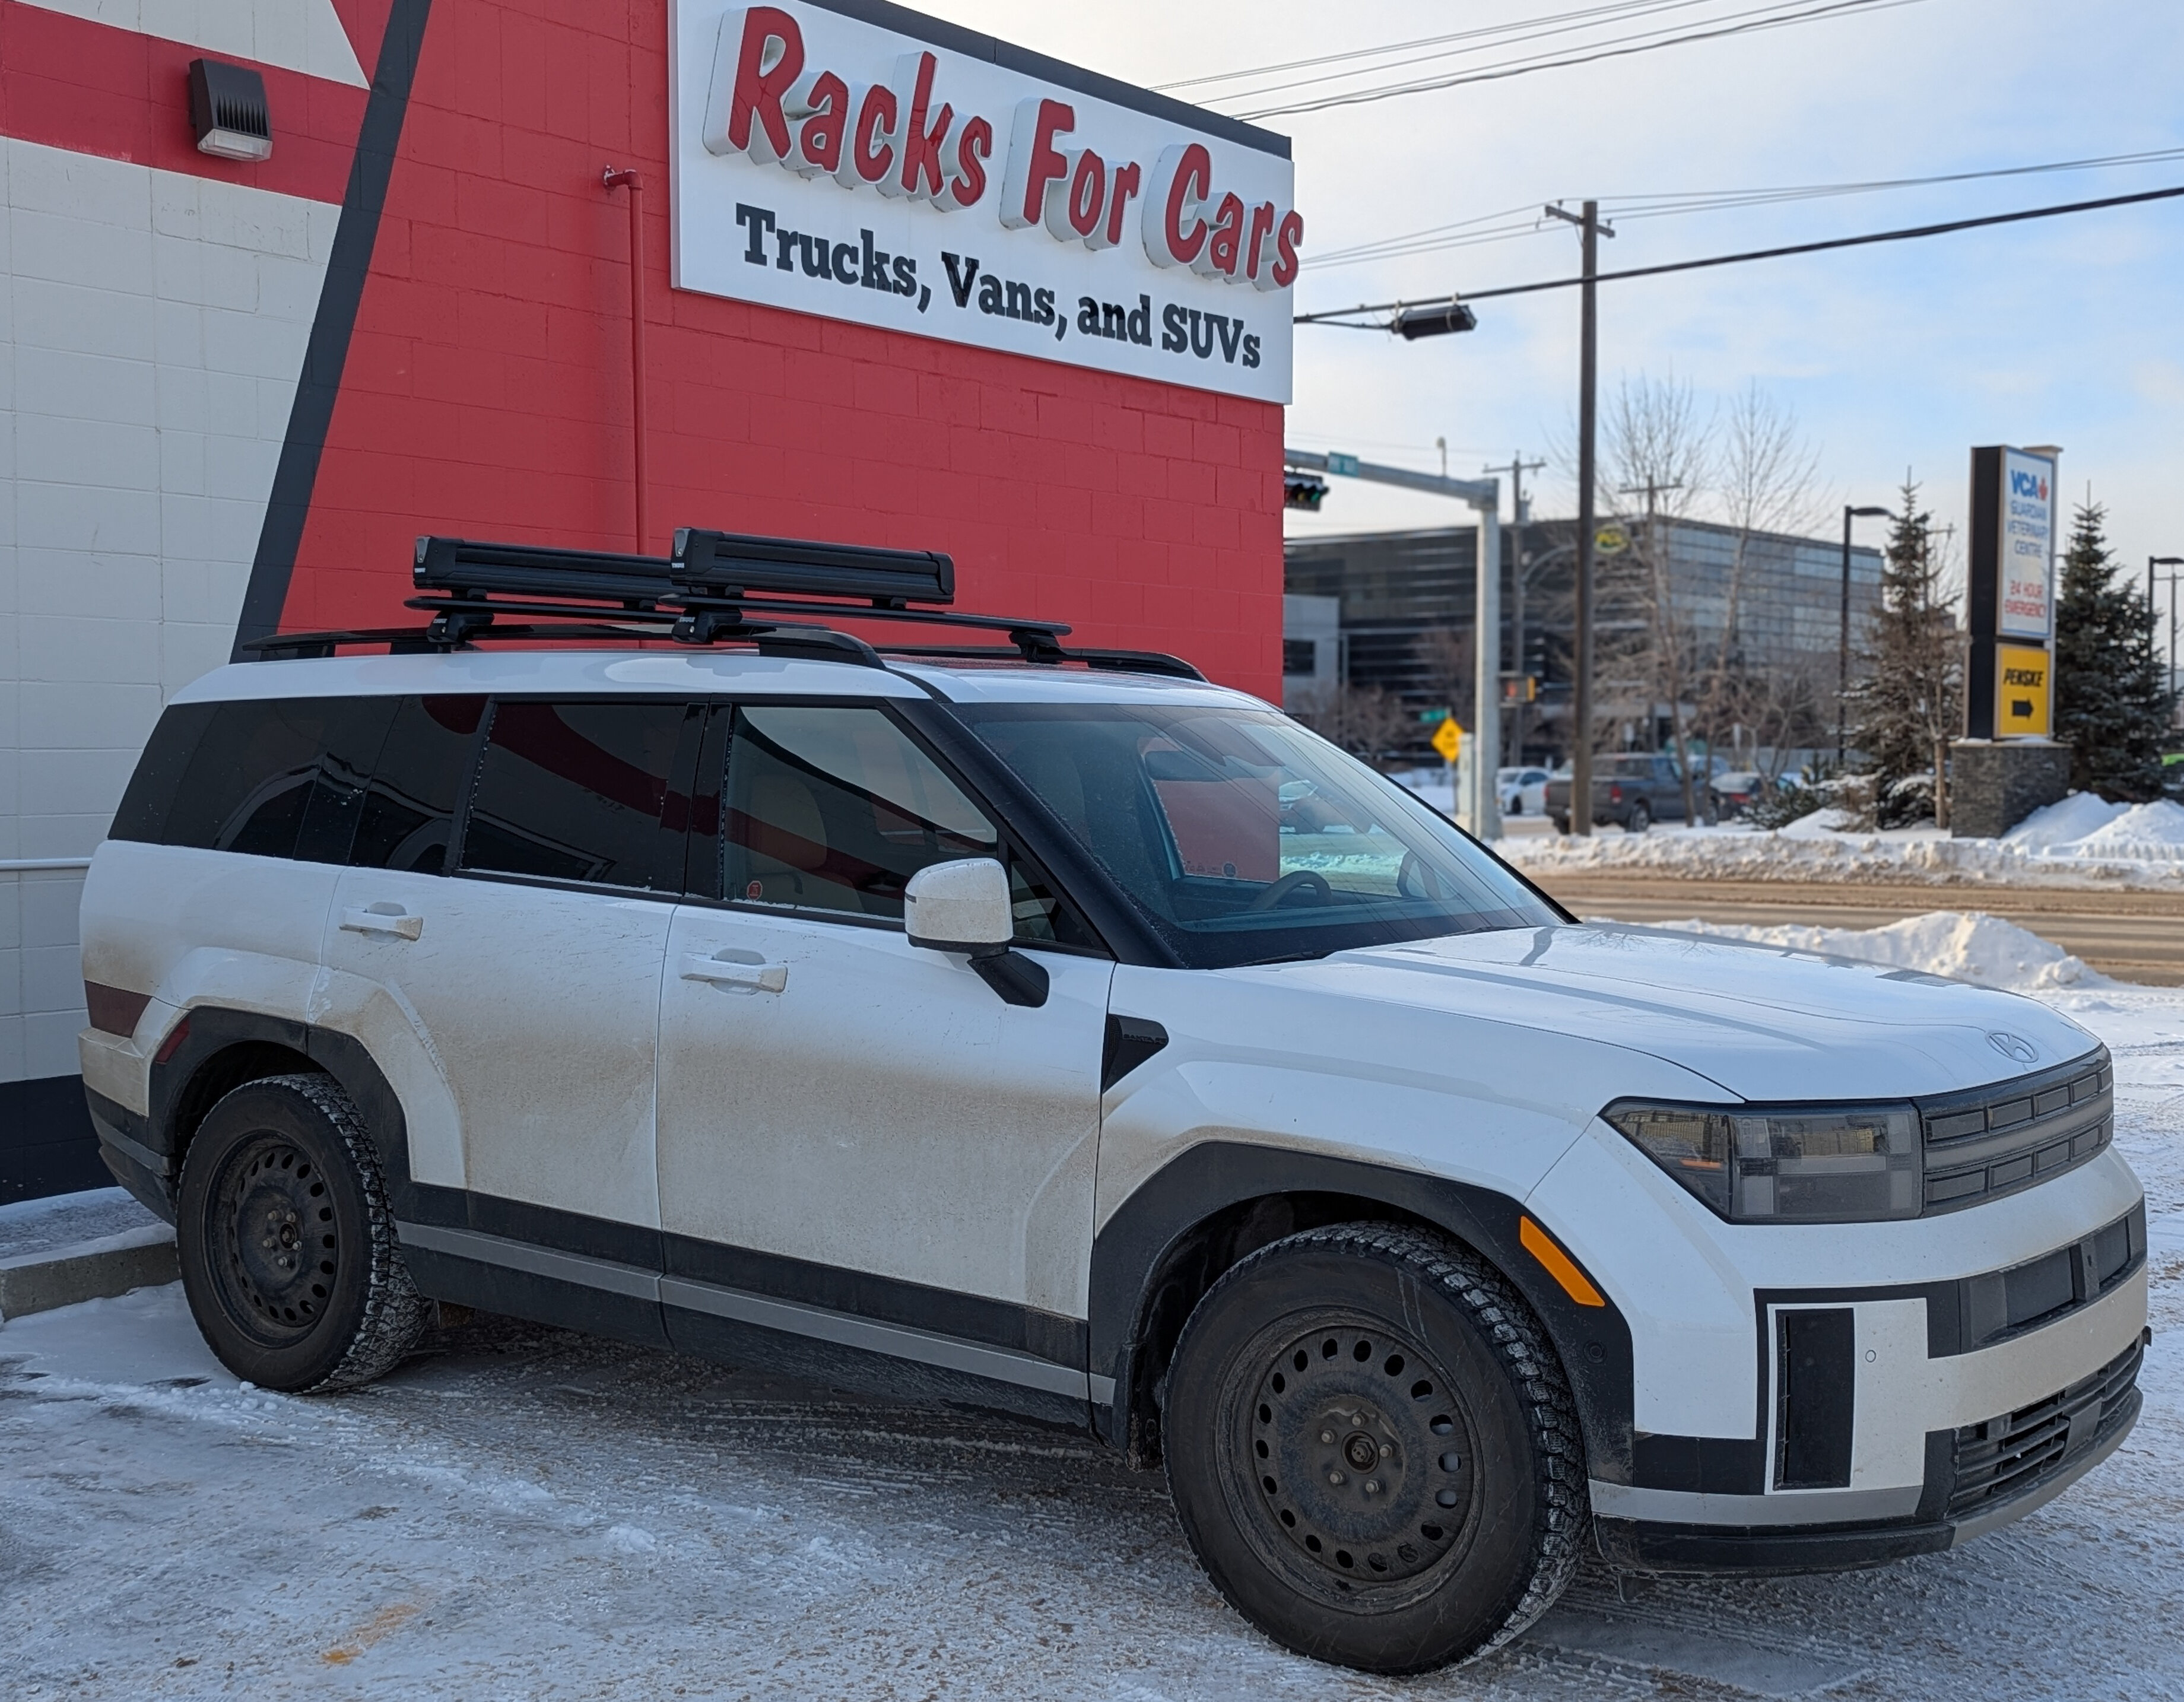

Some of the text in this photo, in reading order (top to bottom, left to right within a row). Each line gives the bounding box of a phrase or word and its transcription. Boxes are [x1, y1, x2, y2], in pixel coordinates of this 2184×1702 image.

[728, 7, 1302, 287] Racks For Cars
[736, 202, 1261, 368] Trucks, Vans, and SUVs
[2010, 469, 2039, 499] VCA
[2010, 579, 2021, 595] 24
[2003, 668, 2044, 687] PENSKE
